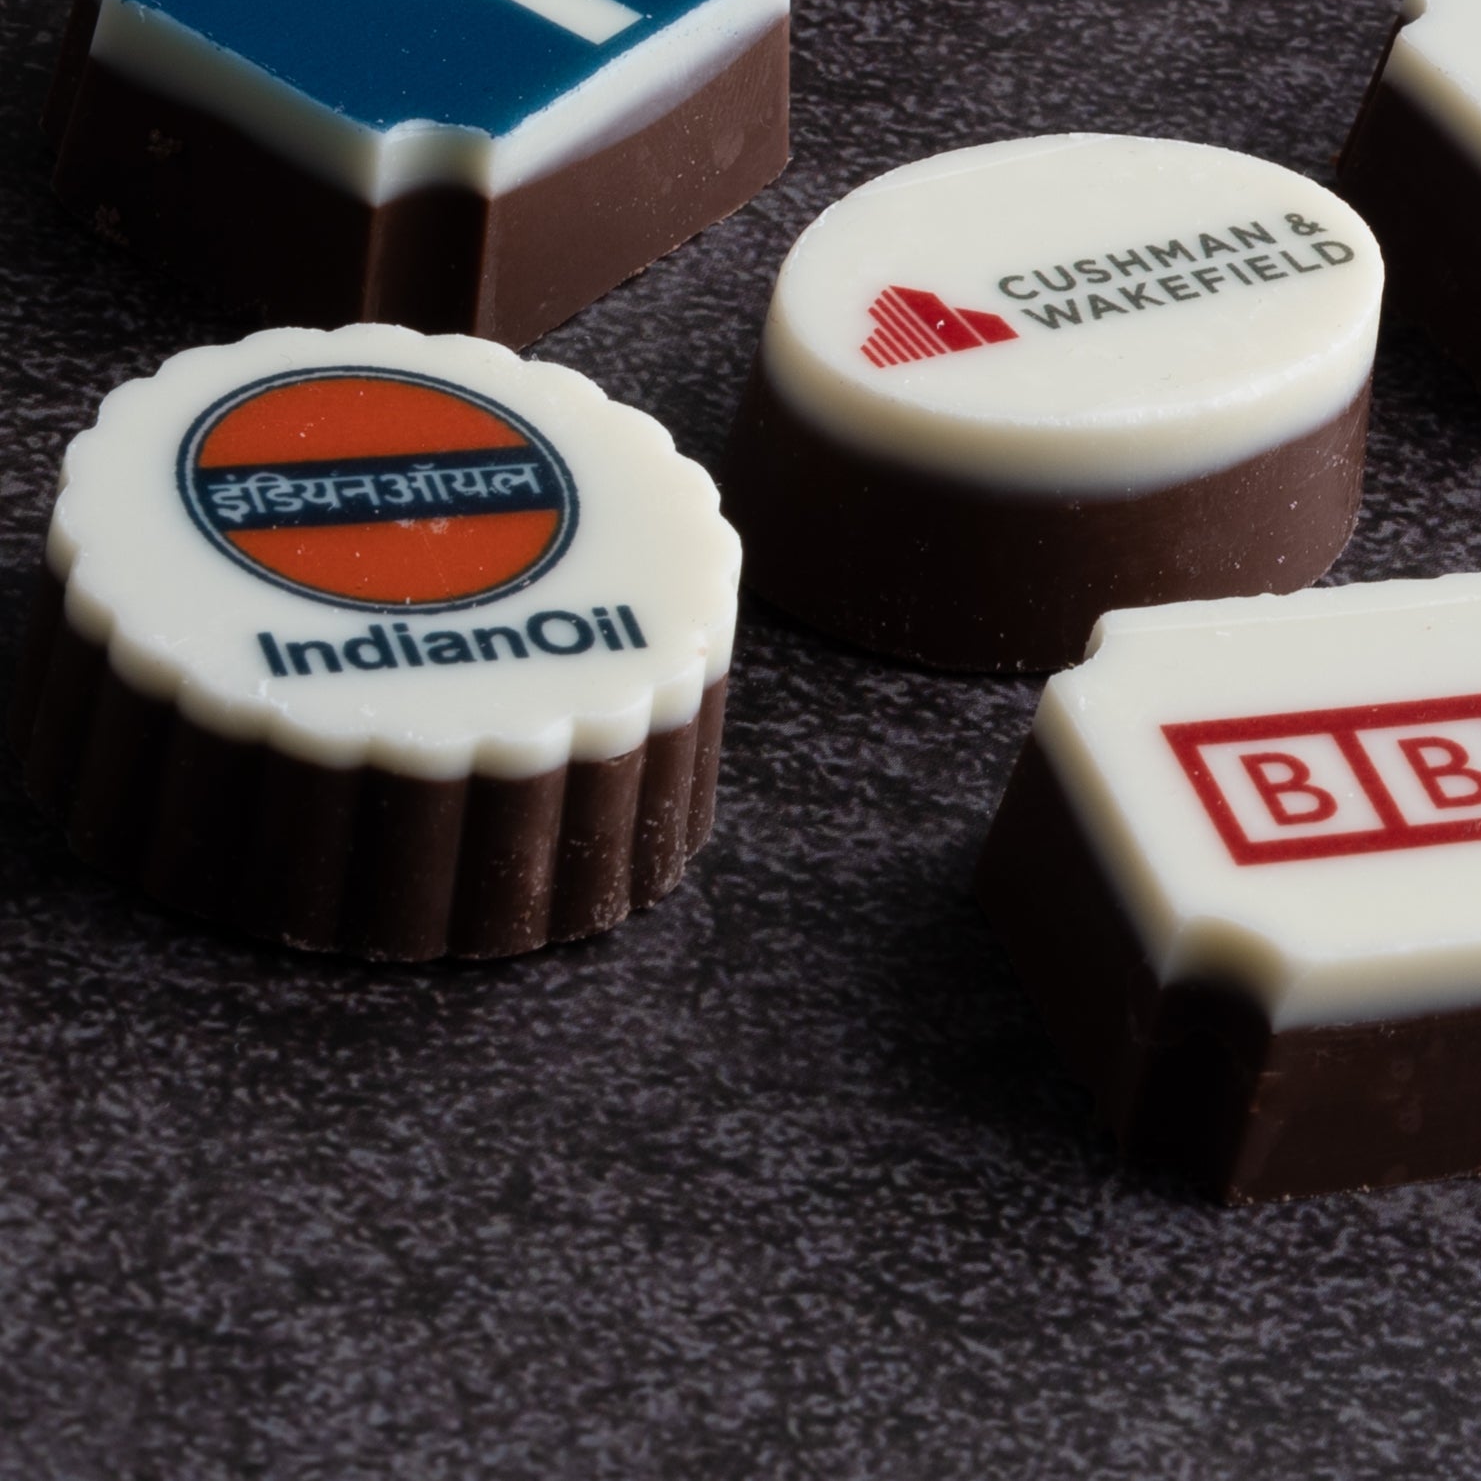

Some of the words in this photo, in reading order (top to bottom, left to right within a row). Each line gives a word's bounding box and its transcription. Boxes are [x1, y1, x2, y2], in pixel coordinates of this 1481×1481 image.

[998, 220, 1278, 301] CUSHMAN
[1283, 212, 1328, 237] &
[1020, 239, 1357, 331] WAKEFIELD
[256, 604, 648, 678] IndianOil
